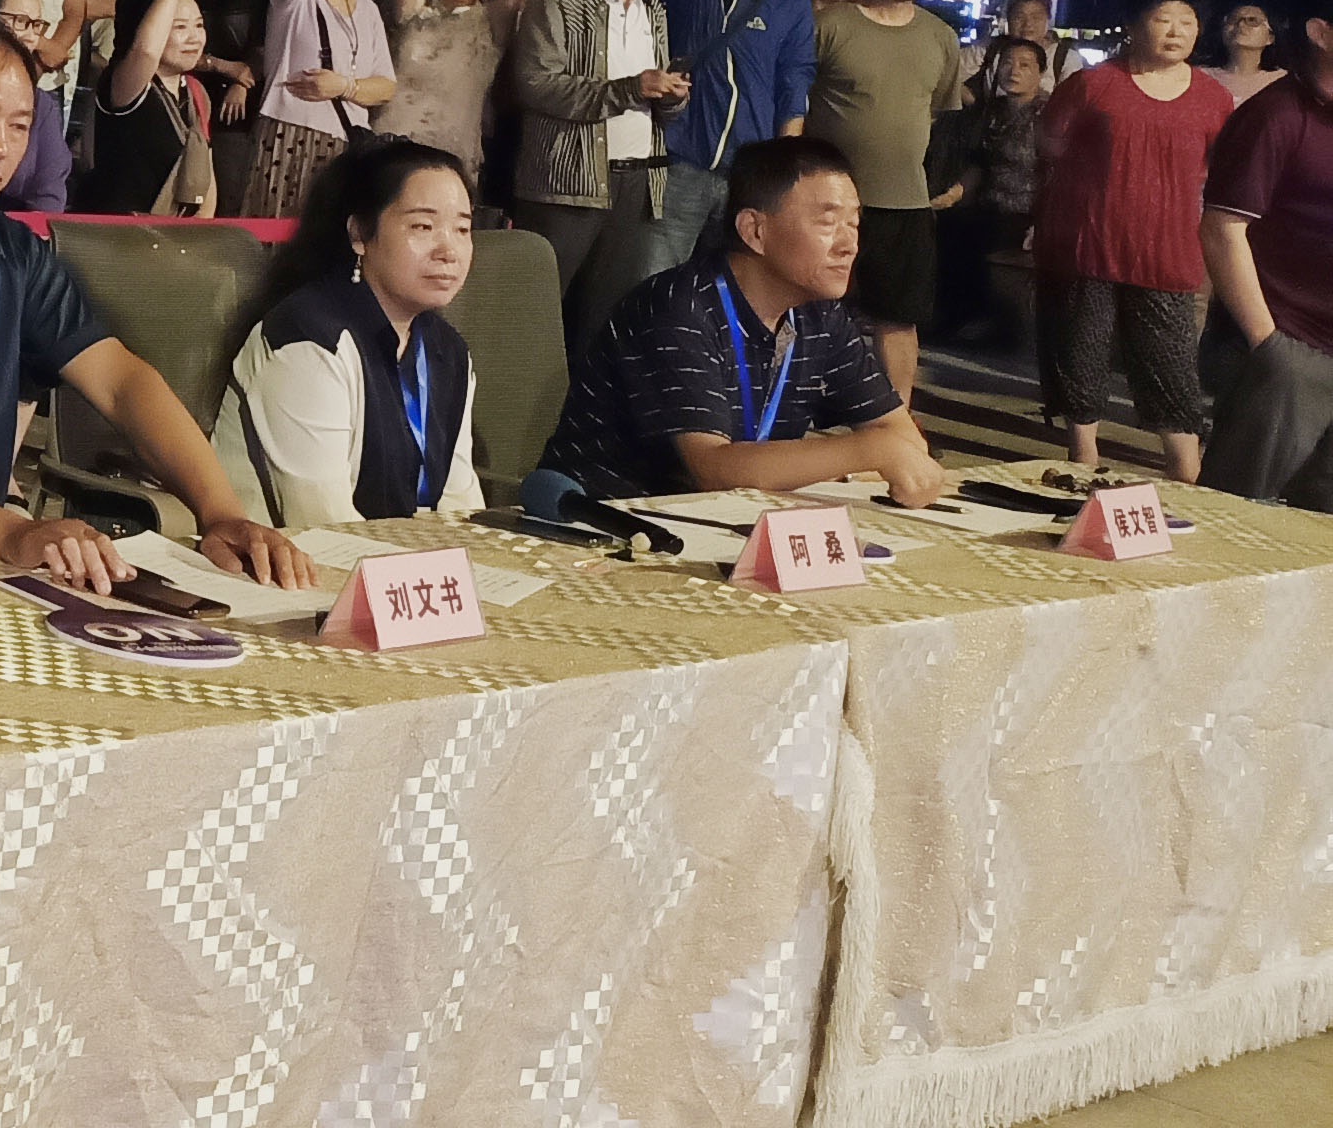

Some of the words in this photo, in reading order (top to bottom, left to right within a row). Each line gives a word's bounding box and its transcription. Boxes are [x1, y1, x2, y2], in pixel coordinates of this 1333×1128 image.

[1112, 504, 1158, 538] 侯文智
[788, 530, 846, 568] 阿桑
[384, 575, 463, 621] 刘文书
[83, 621, 206, 642] ON
